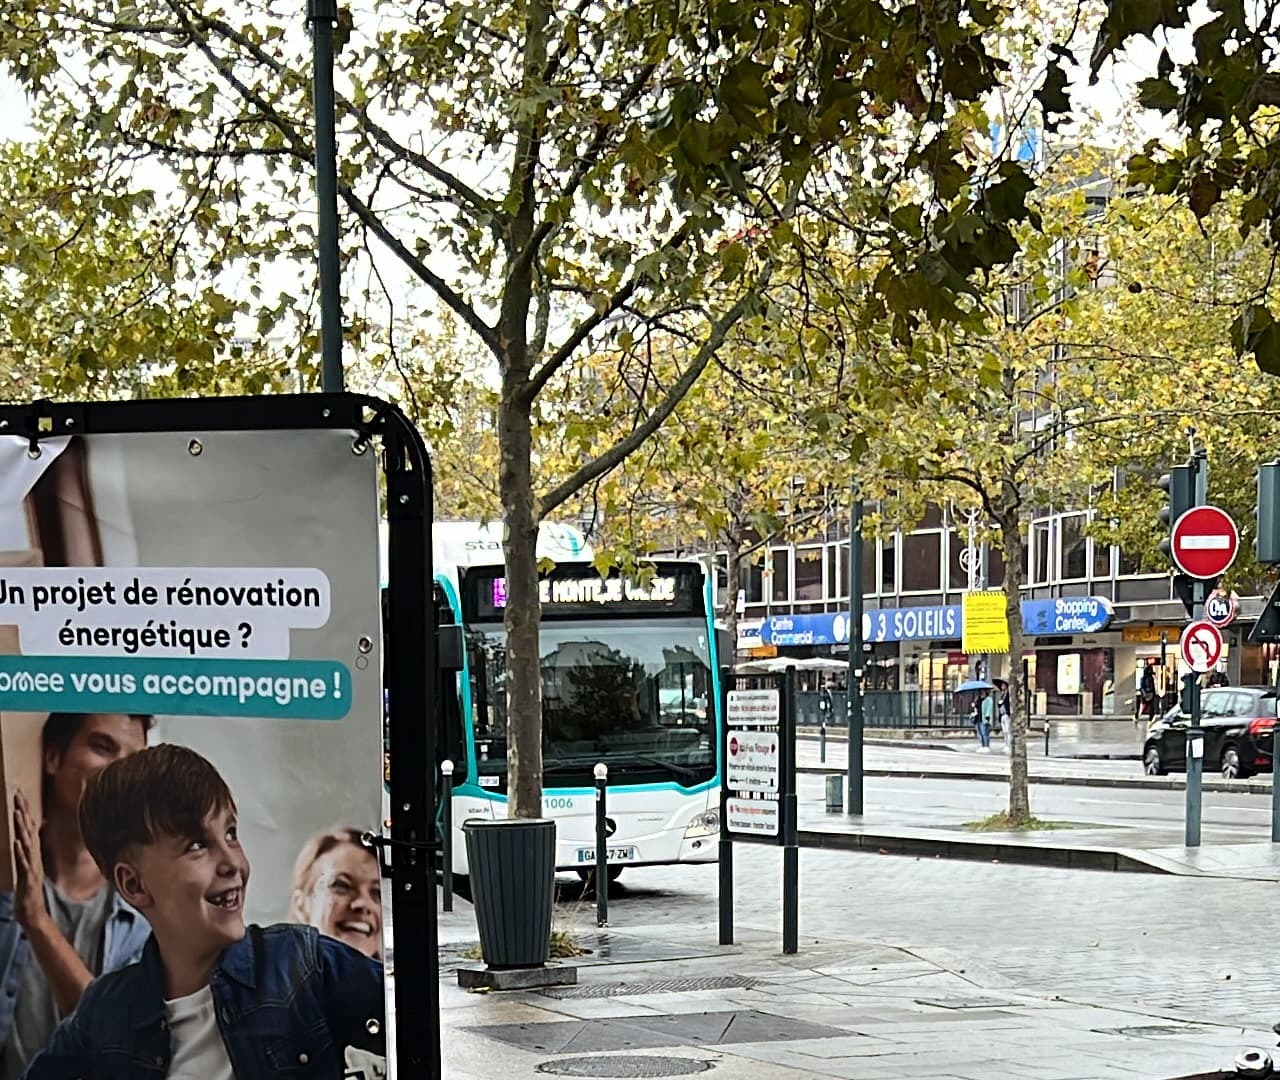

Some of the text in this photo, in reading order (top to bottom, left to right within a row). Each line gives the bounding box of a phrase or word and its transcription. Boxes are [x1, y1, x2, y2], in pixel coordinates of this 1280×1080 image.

[464, 540, 501, 551] sta
[32, 577, 117, 612] projet
[123, 577, 158, 605] de
[166, 577, 320, 608] rénovation
[1055, 598, 1098, 617] Shopping
[58, 618, 253, 655] énergétique ?
[770, 617, 794, 631] Centre
[875, 613, 887, 641] 3
[893, 608, 956, 638] SOLEILS
[70, 672, 137, 694] vous
[143, 673, 327, 705] accompagne
[332, 670, 342, 699] !
[544, 798, 574, 809] 1006
